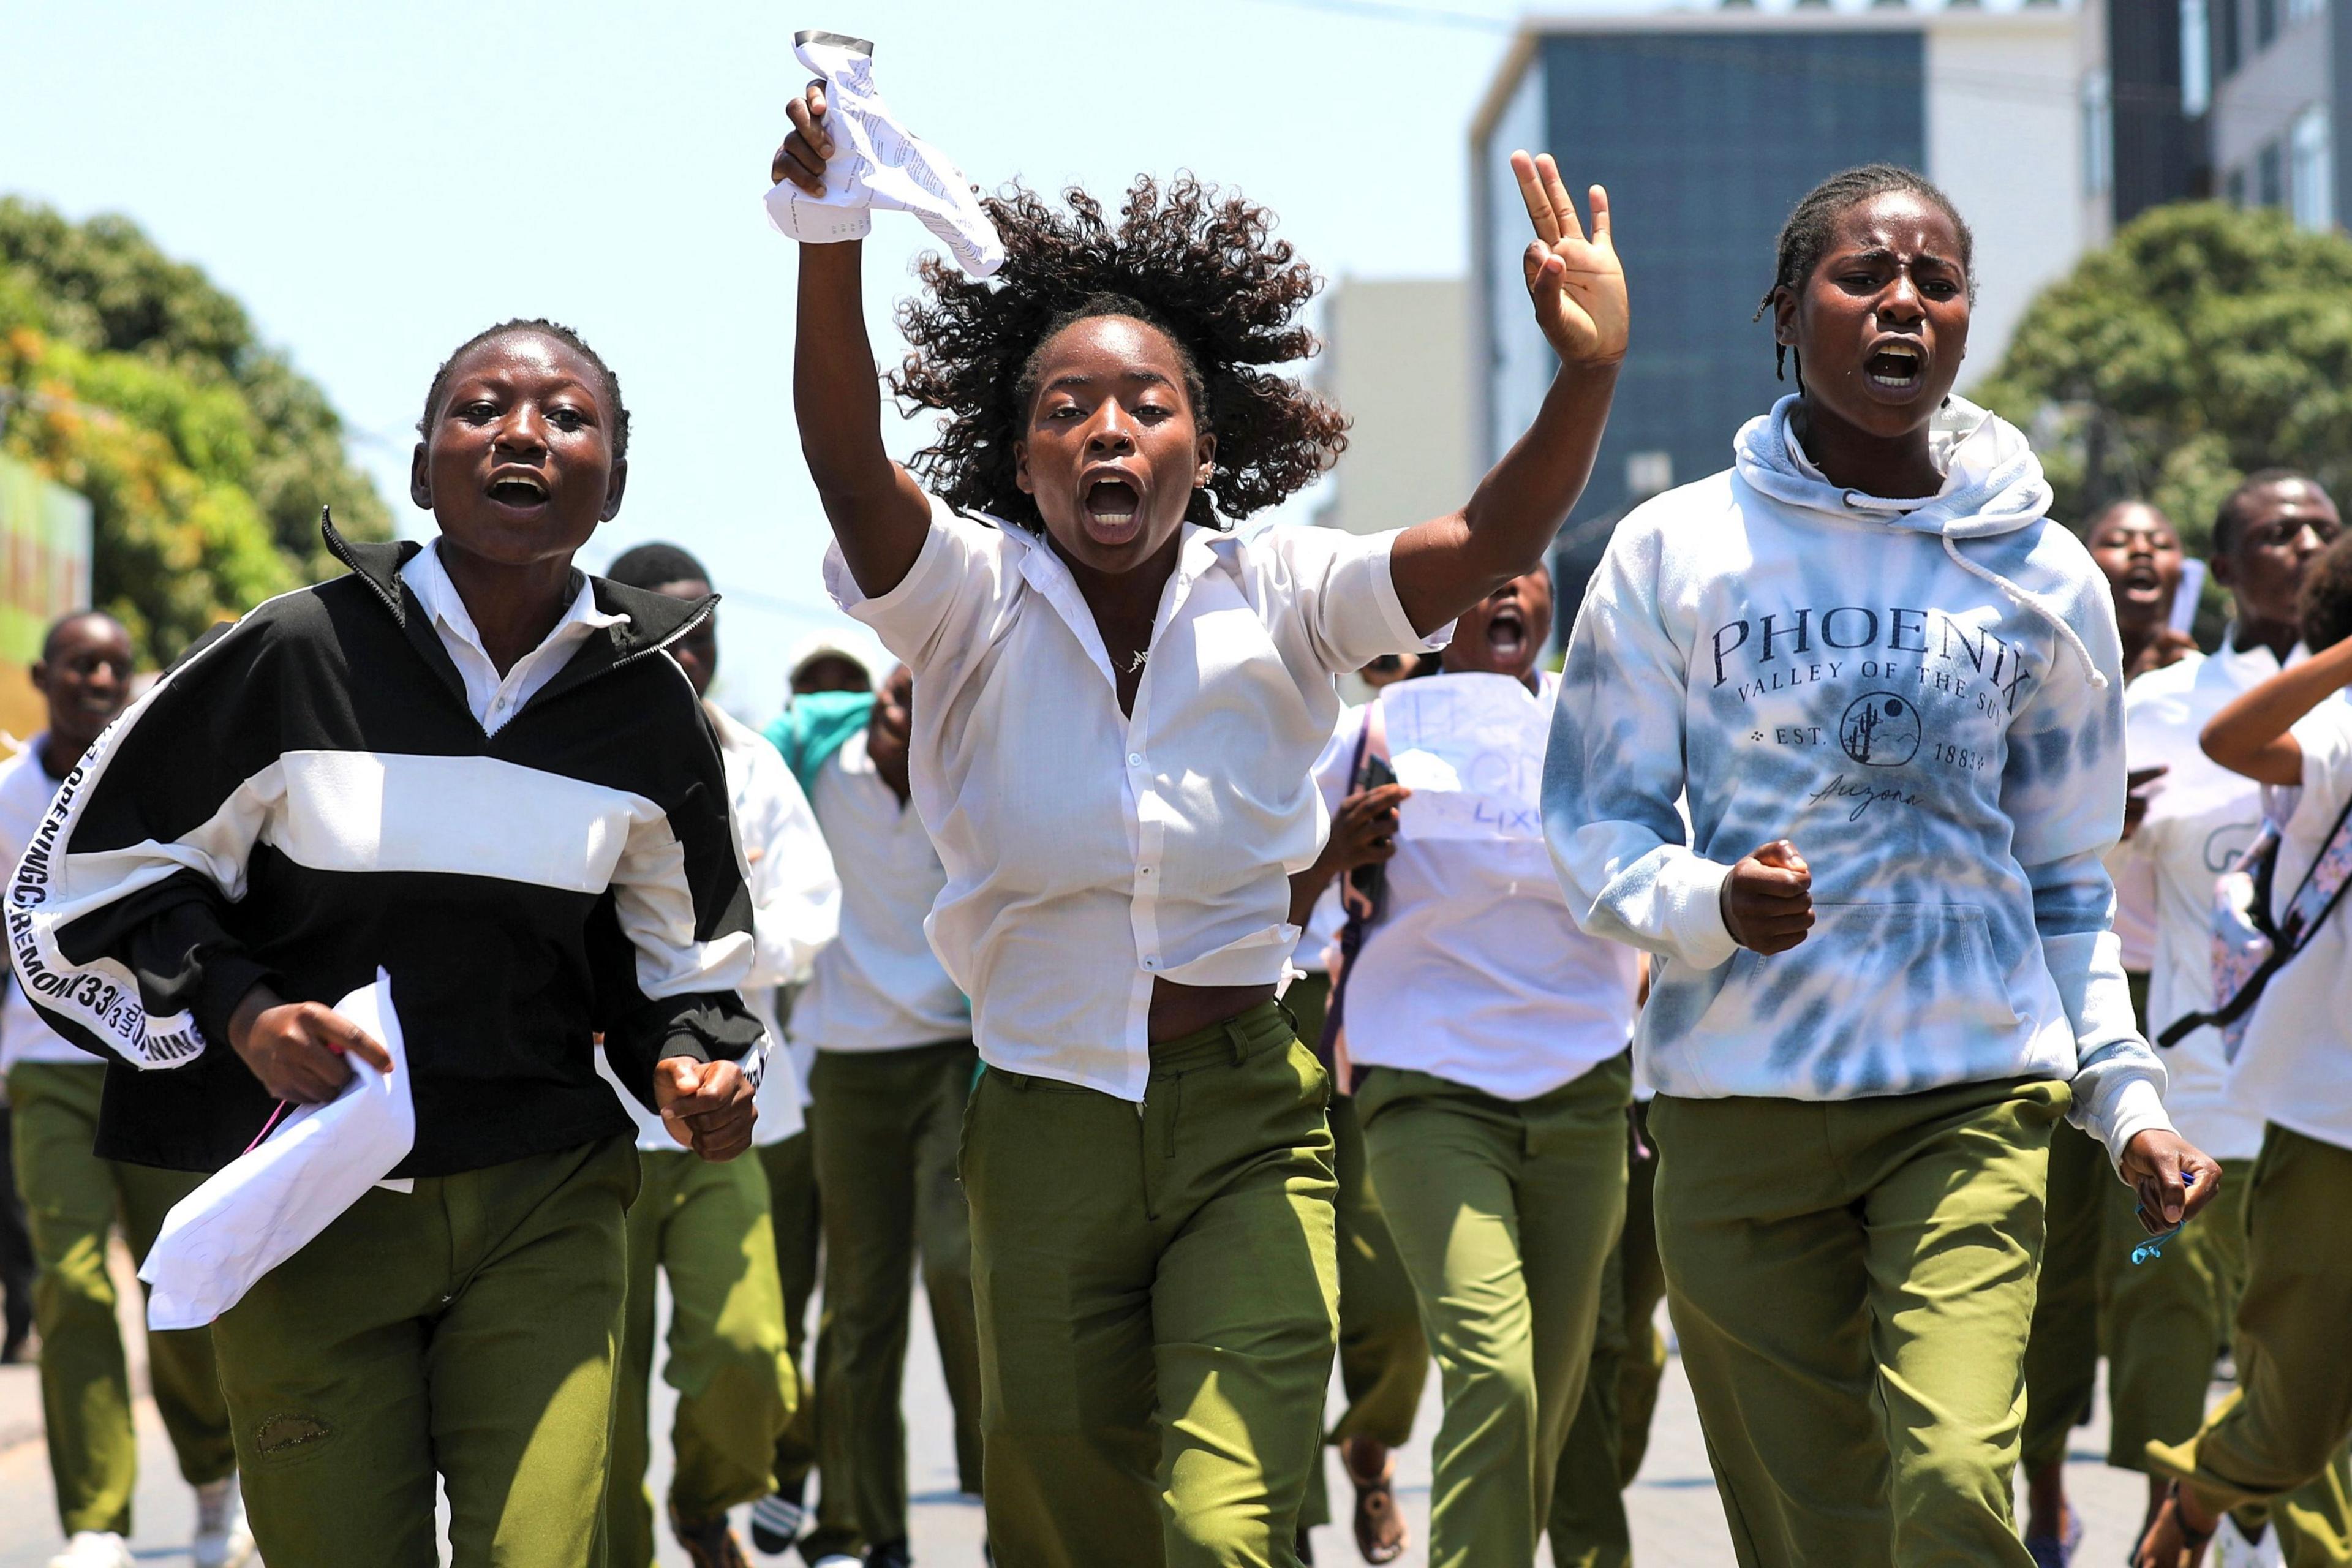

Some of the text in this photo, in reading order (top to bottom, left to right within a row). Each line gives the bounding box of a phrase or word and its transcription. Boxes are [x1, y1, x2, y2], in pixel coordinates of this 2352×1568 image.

[1713, 606, 2031, 716] PHOENIX
[1738, 660, 2003, 727] VALLEY OF THE SUN
[1776, 728, 1827, 746] EST.
[1472, 801, 1541, 832] LIX
[1809, 774, 1927, 822] Arizona
[118, 1003, 143, 1038] rpm
